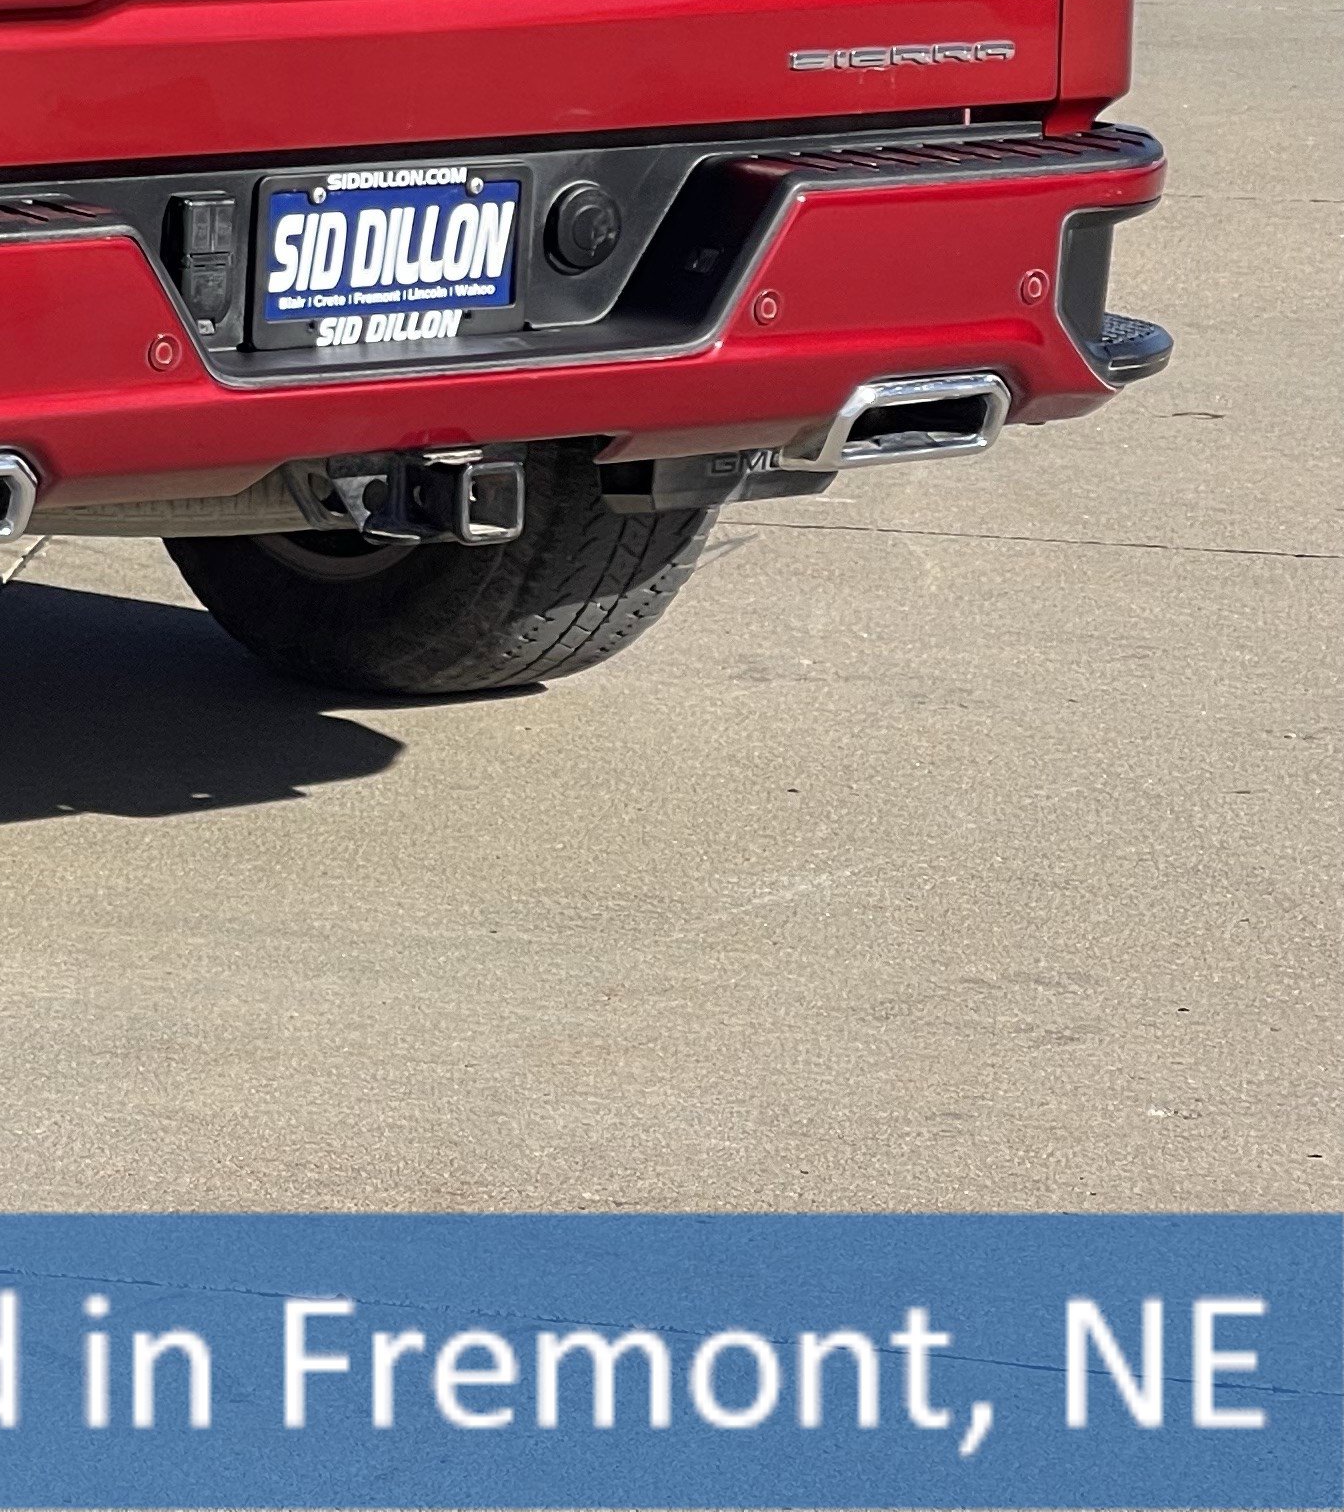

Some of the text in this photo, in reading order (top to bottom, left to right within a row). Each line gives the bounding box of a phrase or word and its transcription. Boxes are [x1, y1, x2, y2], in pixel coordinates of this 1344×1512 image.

[789, 40, 1016, 72] SIERRA
[327, 167, 467, 191] SIDDILLON.COM
[268, 201, 515, 293] SID DILLON
[354, 291, 401, 305] Fremont
[408, 286, 447, 301] Lincoln
[316, 308, 463, 347] SID DILLON
